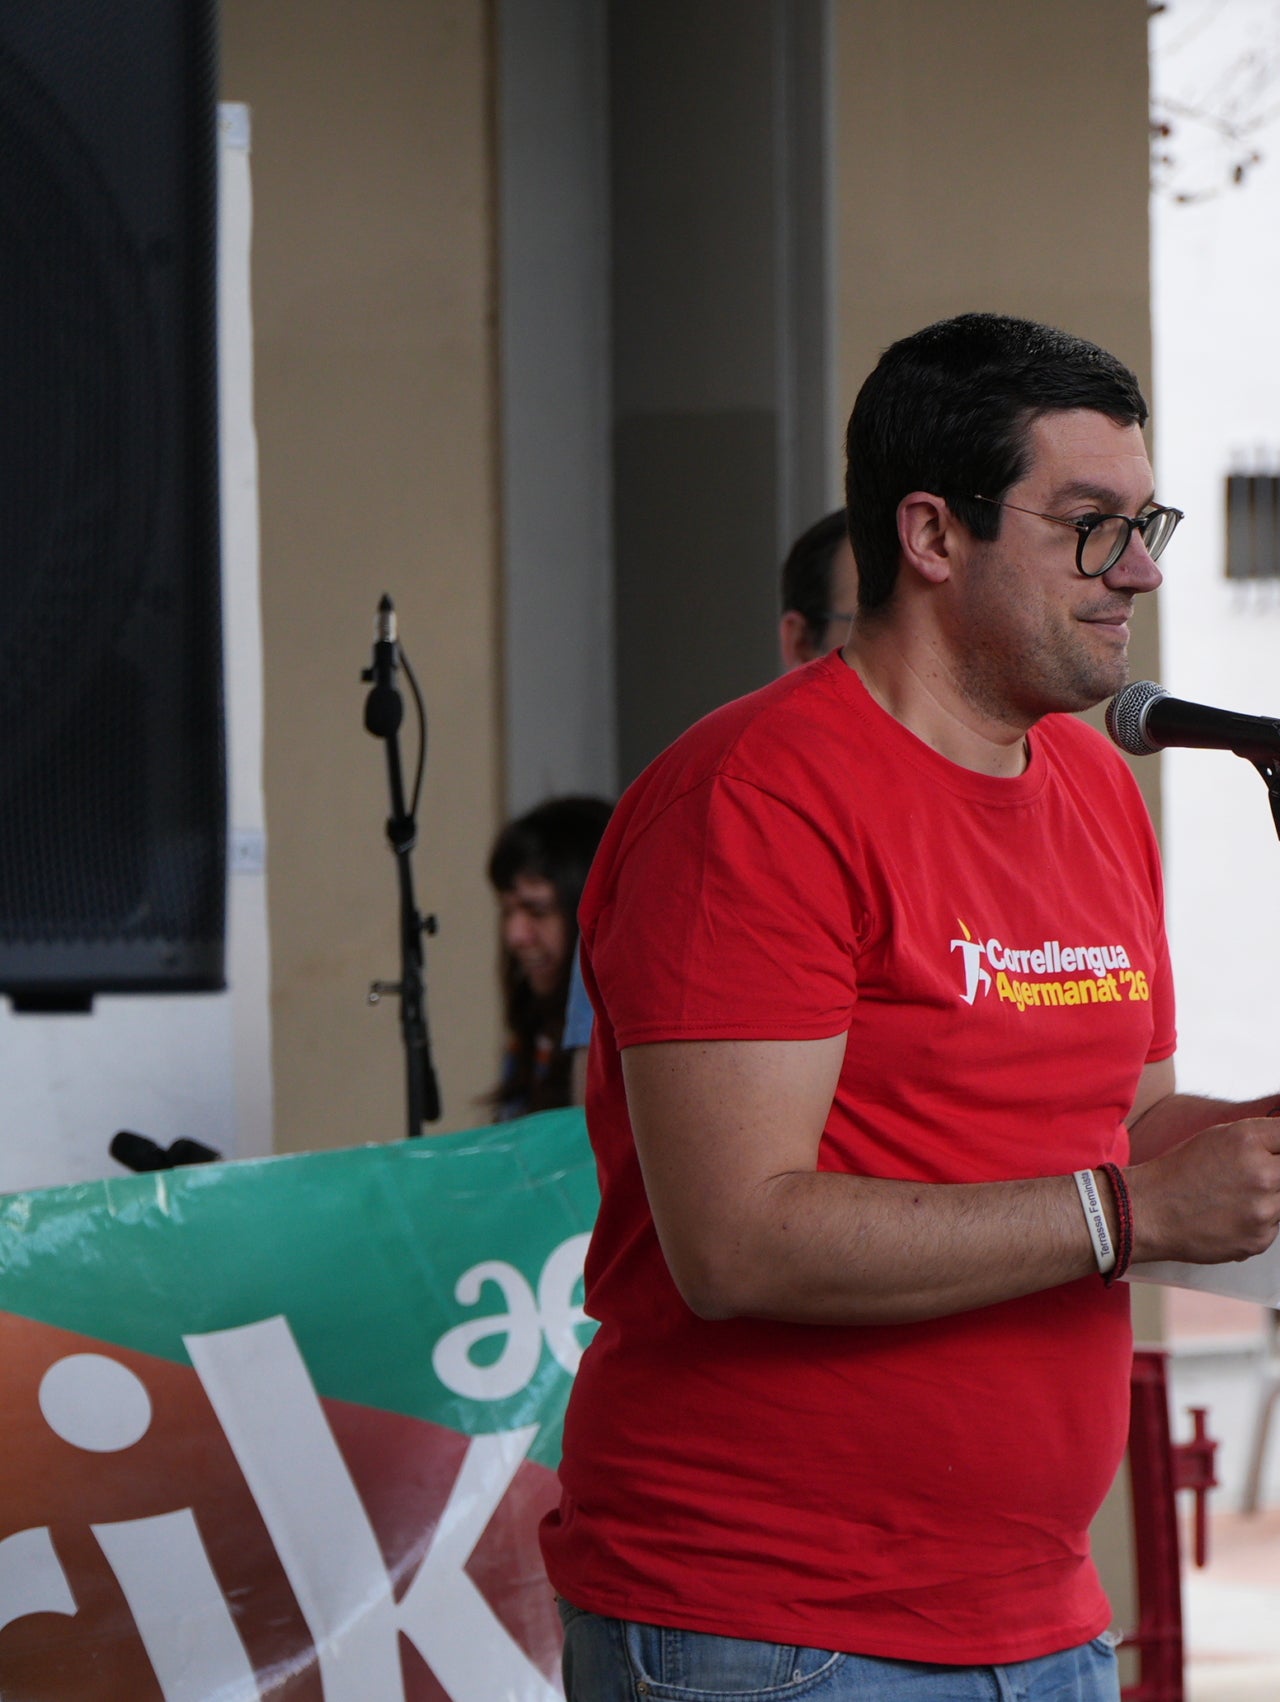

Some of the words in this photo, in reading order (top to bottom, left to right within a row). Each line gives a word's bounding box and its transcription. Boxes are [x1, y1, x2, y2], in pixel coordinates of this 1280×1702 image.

[986, 938, 1131, 977] Correllengua
[995, 972, 1121, 1012] Agermanat
[1120, 970, 1149, 1002] '26
[1094, 1215, 1110, 1257] Terrassa
